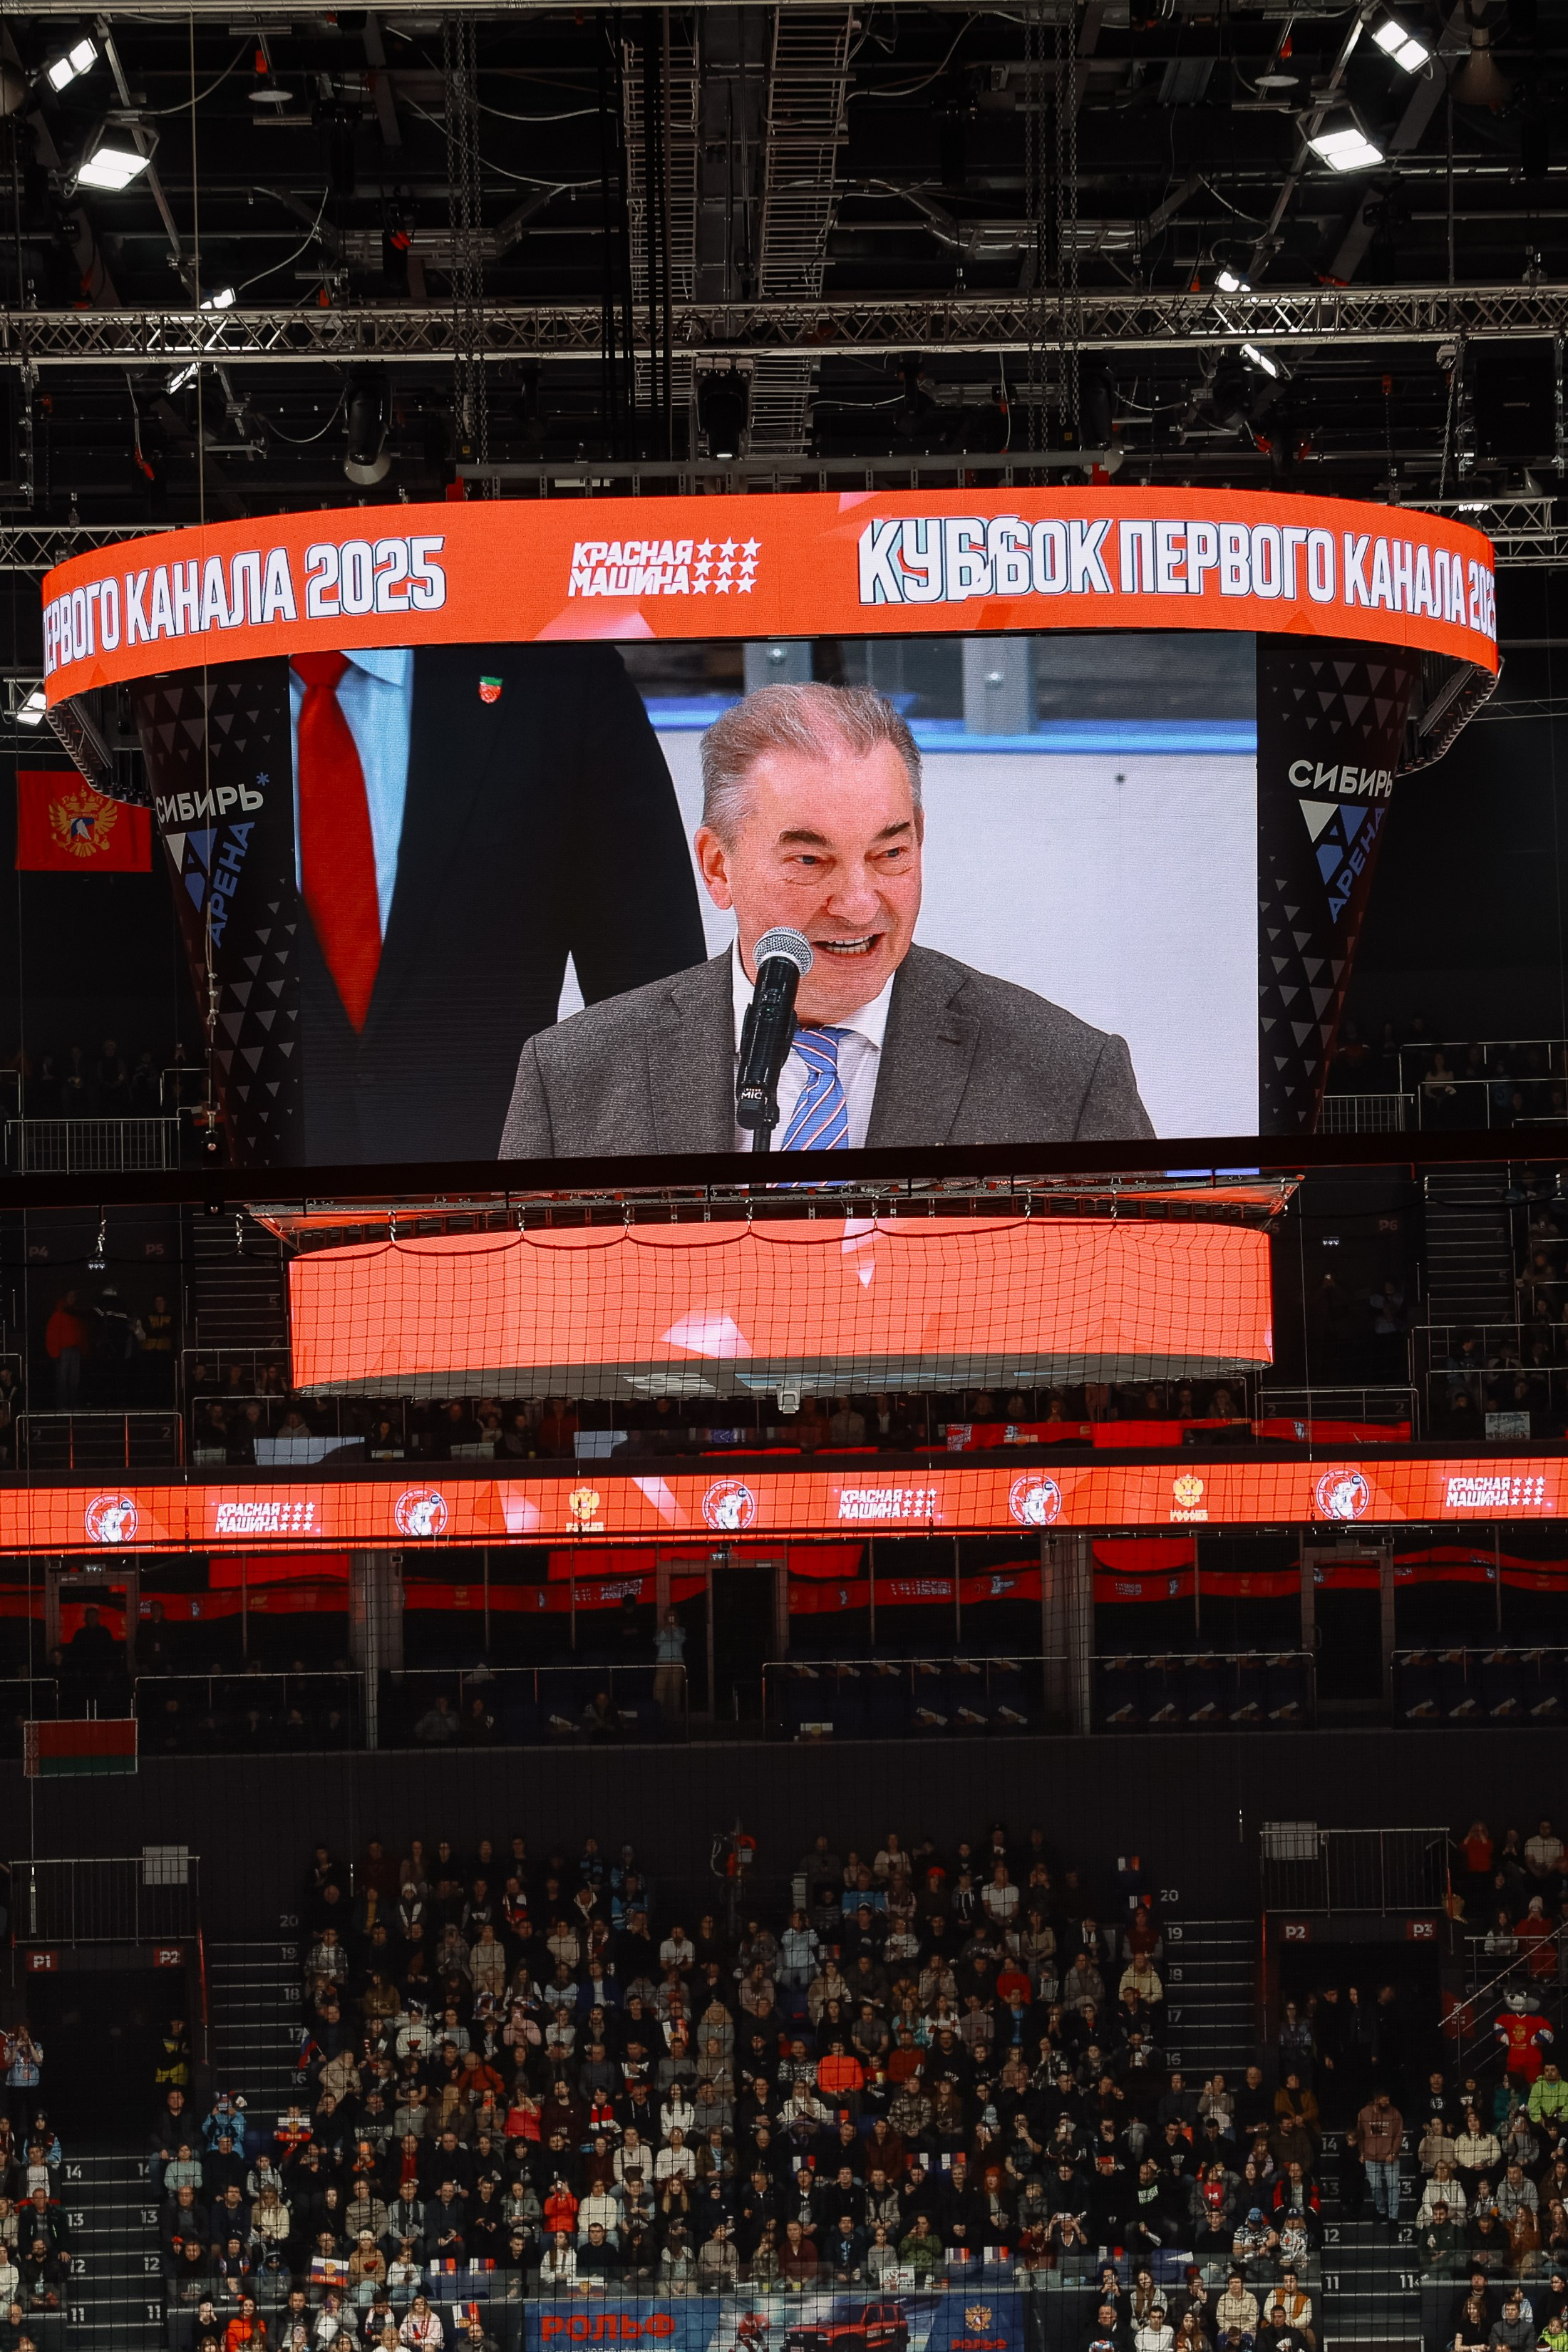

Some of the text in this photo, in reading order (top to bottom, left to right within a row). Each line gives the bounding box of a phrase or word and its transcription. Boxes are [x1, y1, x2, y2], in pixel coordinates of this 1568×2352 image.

[571, 540, 695, 567] КРАСНАЯ
[1119, 520, 1336, 604] ПЕРВОГО
[1343, 532, 1468, 627] КАНАЛА
[567, 565, 691, 597] МАШИНА
[123, 547, 297, 647] КАНАЛА
[305, 535, 447, 620] 2025
[1288, 759, 1393, 798] СИБИРЬ
[155, 783, 264, 824] СИБИРЬ
[1328, 808, 1386, 924] АРЕНА
[210, 821, 256, 949] АРЕНА
[1267, 1405, 1277, 1417] 2
[1396, 1402, 1405, 1414] 2
[32, 1429, 41, 1441] 2
[162, 1426, 172, 1438] 2
[1448, 1477, 1511, 1491] КРАСНАЯ
[841, 1489, 903, 1503] КРАСНАЯ
[1445, 1491, 1510, 1507] МАШИНА
[217, 1502, 280, 1517] КРАСНАЯ
[837, 1502, 901, 1519] МАШИНА
[215, 1517, 278, 1532] МАШИНА
[1160, 1889, 1180, 1902] 20
[280, 1914, 298, 1928] 20
[1167, 1927, 1183, 1940] 19
[281, 1947, 297, 1960] 19
[1169, 1968, 1183, 1981] 18
[284, 1988, 300, 2001] 18
[1167, 2009, 1182, 2023] 17
[288, 2027, 303, 2041] 17
[1166, 2053, 1182, 2066] 16
[290, 2071, 307, 2084] 16
[1321, 2137, 1337, 2150] 14
[66, 2165, 82, 2180] 14
[1322, 2181, 1340, 2195] 13
[67, 2212, 84, 2227] 13
[140, 2209, 158, 2224] 13
[1324, 2228, 1340, 2242] 12
[1398, 2228, 1413, 2242] 12
[70, 2259, 86, 2274] 12
[144, 2256, 160, 2271] 12
[1326, 2276, 1339, 2289] 11
[1400, 2274, 1414, 2289] 11
[71, 2307, 85, 2322] 11
[147, 2304, 161, 2319] 11
[541, 2313, 676, 2341] РОЛЬФ
[951, 2338, 1008, 2350] РОЛЬФ
